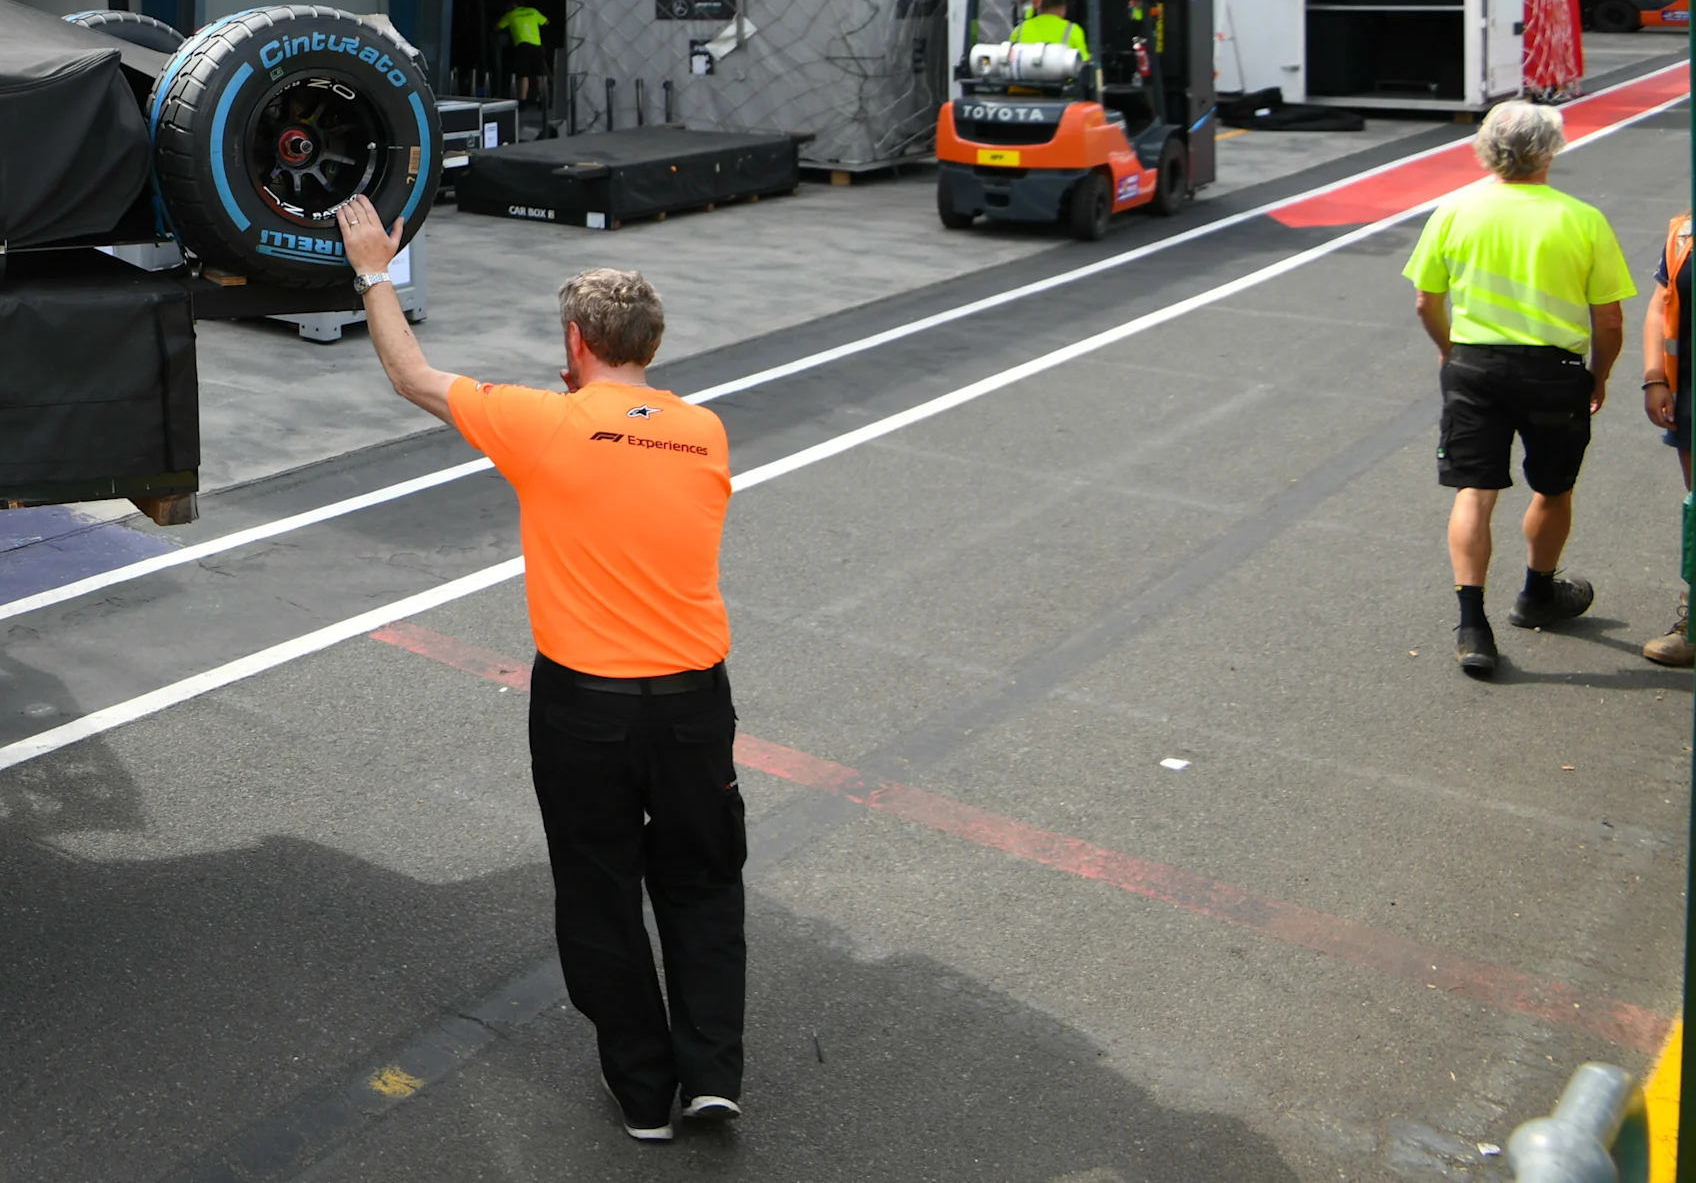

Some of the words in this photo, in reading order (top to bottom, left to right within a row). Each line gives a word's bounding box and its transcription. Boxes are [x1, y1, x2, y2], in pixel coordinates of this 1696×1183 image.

[962, 105, 1044, 121] TOYOTA
[508, 205, 526, 216] CAR
[528, 207, 546, 219] BOX
[258, 229, 345, 258] IRELLI
[627, 435, 708, 456] Experiences
